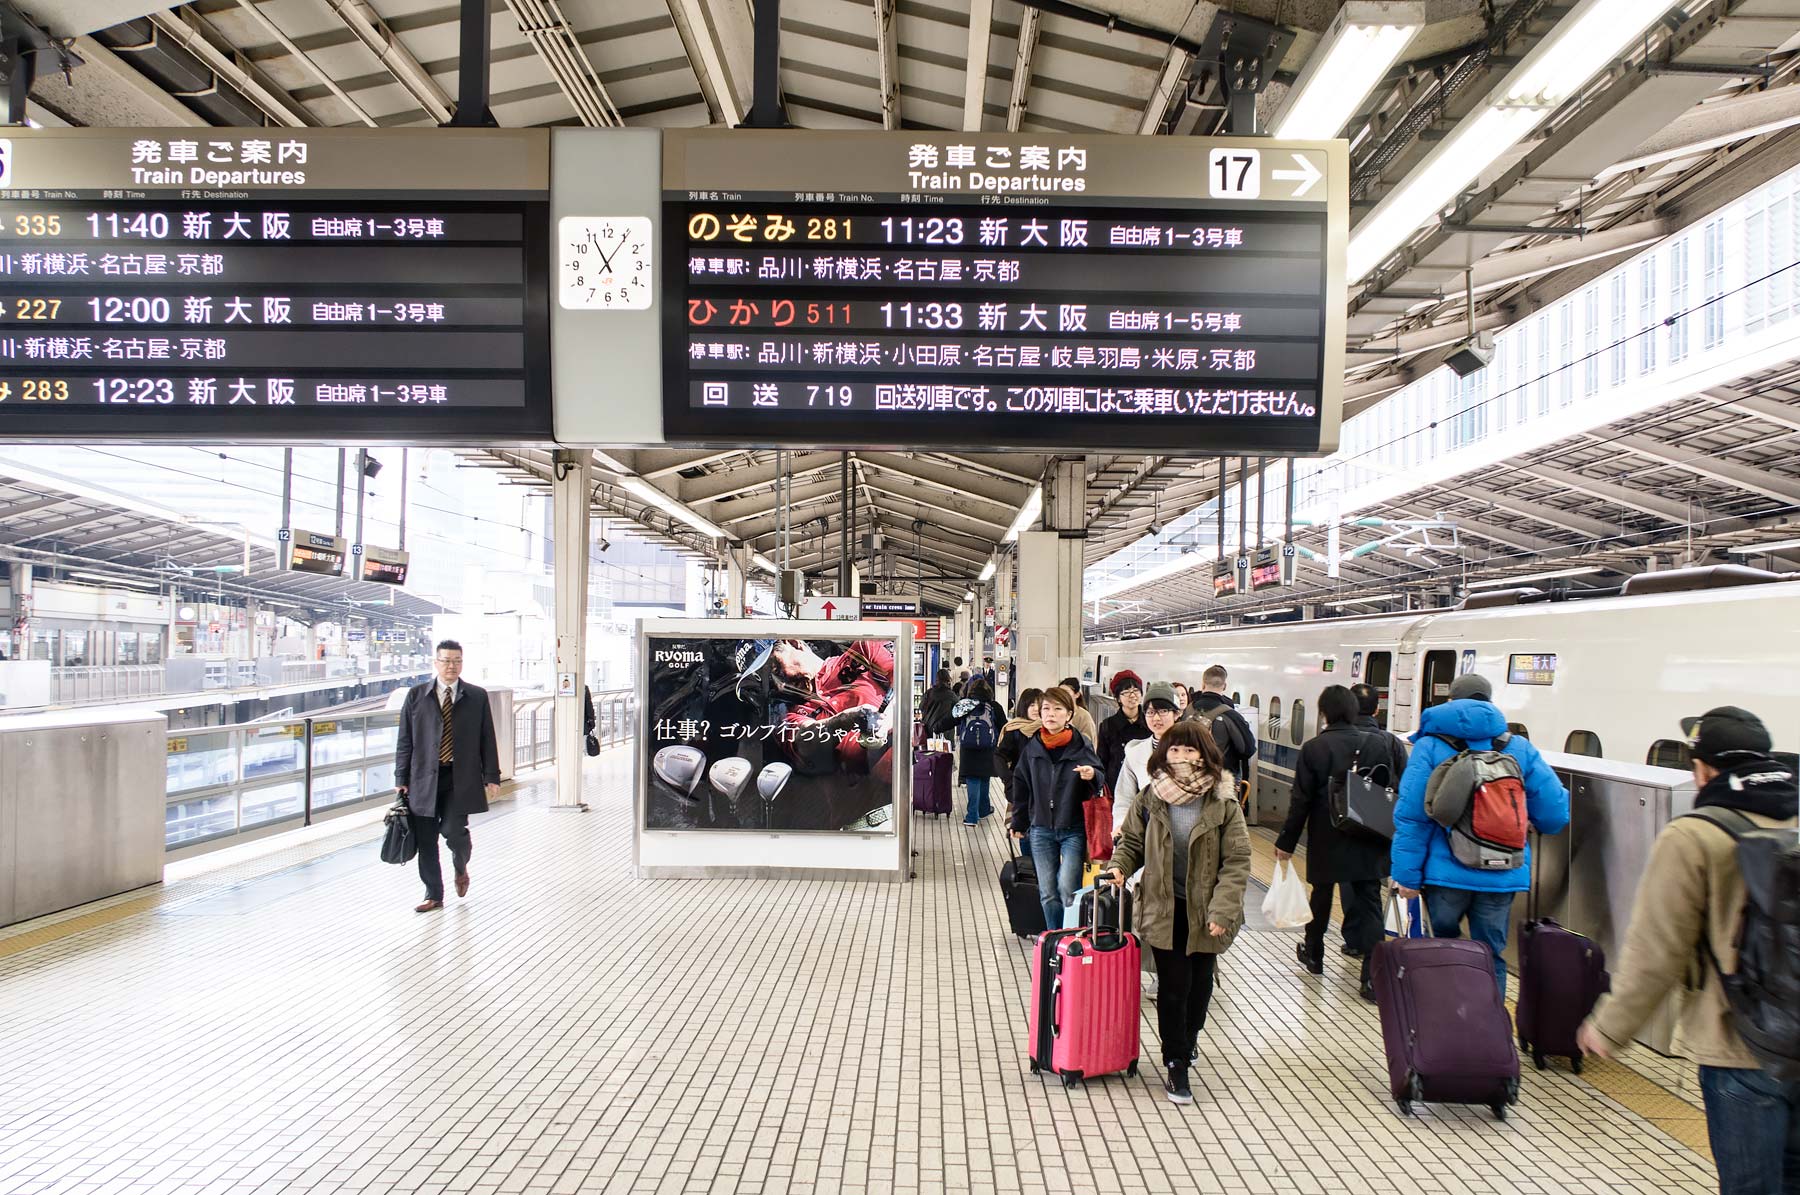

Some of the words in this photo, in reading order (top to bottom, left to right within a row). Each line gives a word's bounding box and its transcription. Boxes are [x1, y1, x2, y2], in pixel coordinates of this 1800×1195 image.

[131, 139, 308, 165] 発車ご案内
[908, 143, 1087, 171] 発車ご案内
[130, 167, 184, 185] Train
[190, 167, 306, 188] Departures
[1214, 155, 1253, 192] 17
[908, 171, 962, 190] Train
[969, 172, 1086, 194] Departures
[0, 190, 41, 200] 列車番号
[43, 190, 63, 199] Train
[64, 190, 79, 199] No.
[103, 189, 124, 199] 時刻
[126, 190, 146, 199] Time
[181, 189, 202, 199] 行先
[204, 189, 250, 199] Destination
[688, 191, 719, 202] 列車名
[721, 191, 742, 202] Train
[794, 192, 835, 203] 列車番号
[837, 193, 859, 203] Train
[860, 193, 875, 202] No.
[900, 193, 921, 204] 時刻
[923, 194, 944, 204] Time
[980, 195, 1001, 205] 行先
[1003, 195, 1050, 206] Destination
[15, 214, 61, 236] 335
[86, 212, 169, 239] 11:40
[182, 211, 291, 240] 新大阪
[688, 213, 796, 243] のぞみ
[807, 218, 851, 240] 281
[880, 216, 964, 245] 11:23
[979, 216, 1089, 248] 新大阪
[602, 228, 614, 238] 12
[577, 244, 587, 254] 10
[632, 244, 639, 254] 2
[572, 260, 580, 270] 9
[636, 260, 643, 270] 3
[688, 256, 750, 275] 停車駅:
[577, 276, 584, 286] 8
[631, 276, 638, 286] 4
[589, 288, 596, 298] 7
[605, 292, 612, 302] 6
[620, 288, 628, 298] 5
[16, 298, 62, 320] 227
[87, 296, 171, 323] 12:00
[183, 295, 292, 324] 新大阪
[688, 298, 795, 327] ひかり
[807, 303, 850, 324] 511
[880, 302, 963, 330] 11:33
[978, 302, 1088, 332] 新大阪
[688, 342, 750, 360] 停車駅:
[22, 380, 69, 401] 283
[92, 378, 175, 405] 12:23
[188, 377, 296, 405] 新大阪
[703, 382, 779, 407] 回送
[806, 385, 853, 407] 719
[280, 531, 289, 540] 12
[353, 545, 362, 554] 13
[1283, 546, 1294, 556] 12
[1238, 559, 1247, 569] 13
[655, 650, 704, 662] Ryoma
[1352, 655, 1361, 677] 13
[1462, 654, 1475, 674] 12
